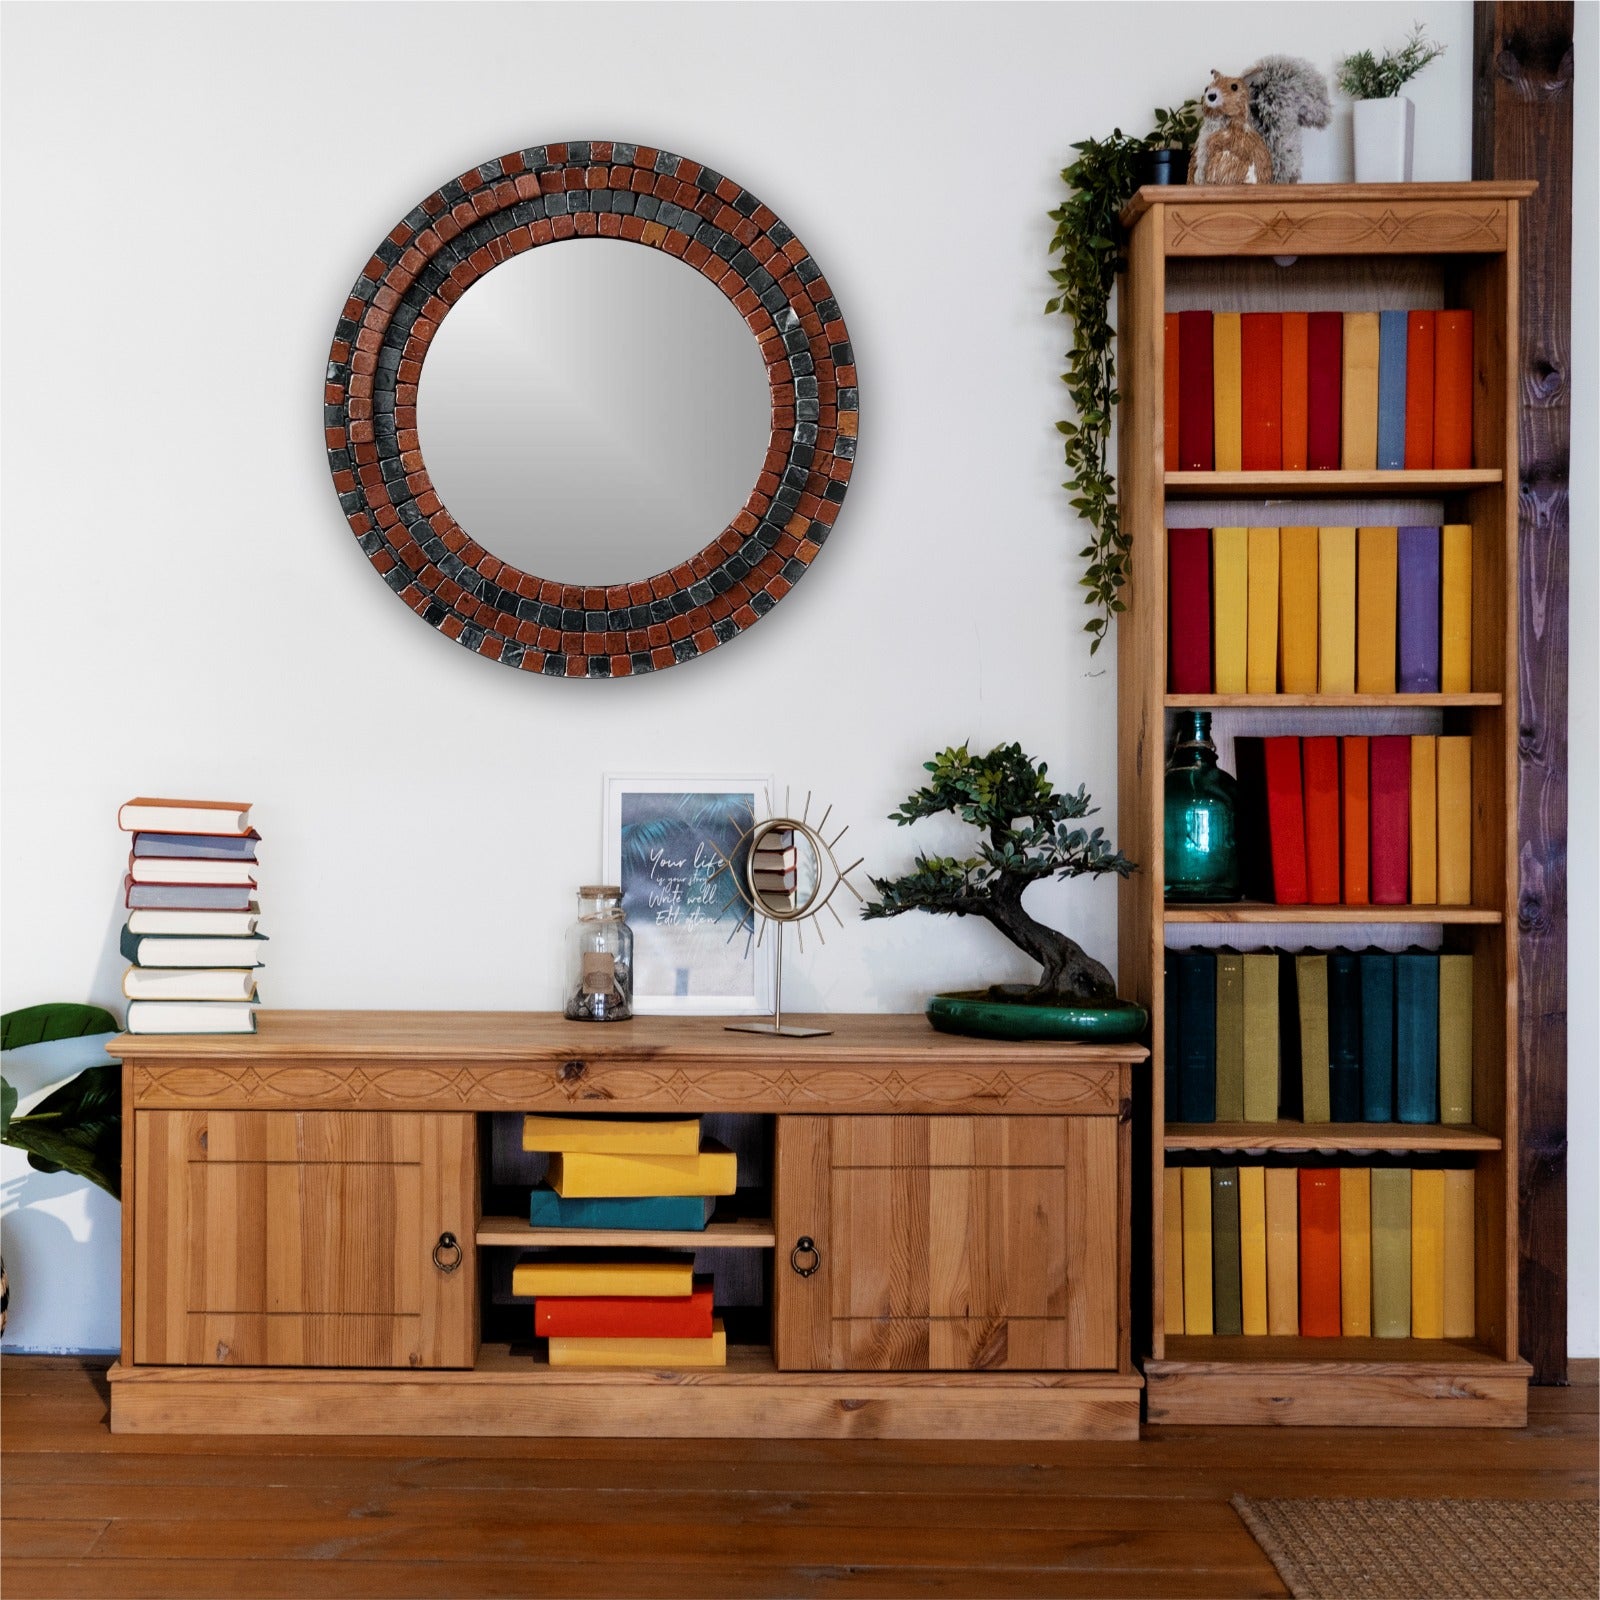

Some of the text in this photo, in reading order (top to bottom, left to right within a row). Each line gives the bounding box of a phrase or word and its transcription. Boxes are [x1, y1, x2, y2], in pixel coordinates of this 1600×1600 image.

[650, 841, 725, 879] Your life
[649, 884, 684, 908] Write
[663, 877, 687, 893] your
[656, 905, 684, 926] Edit
